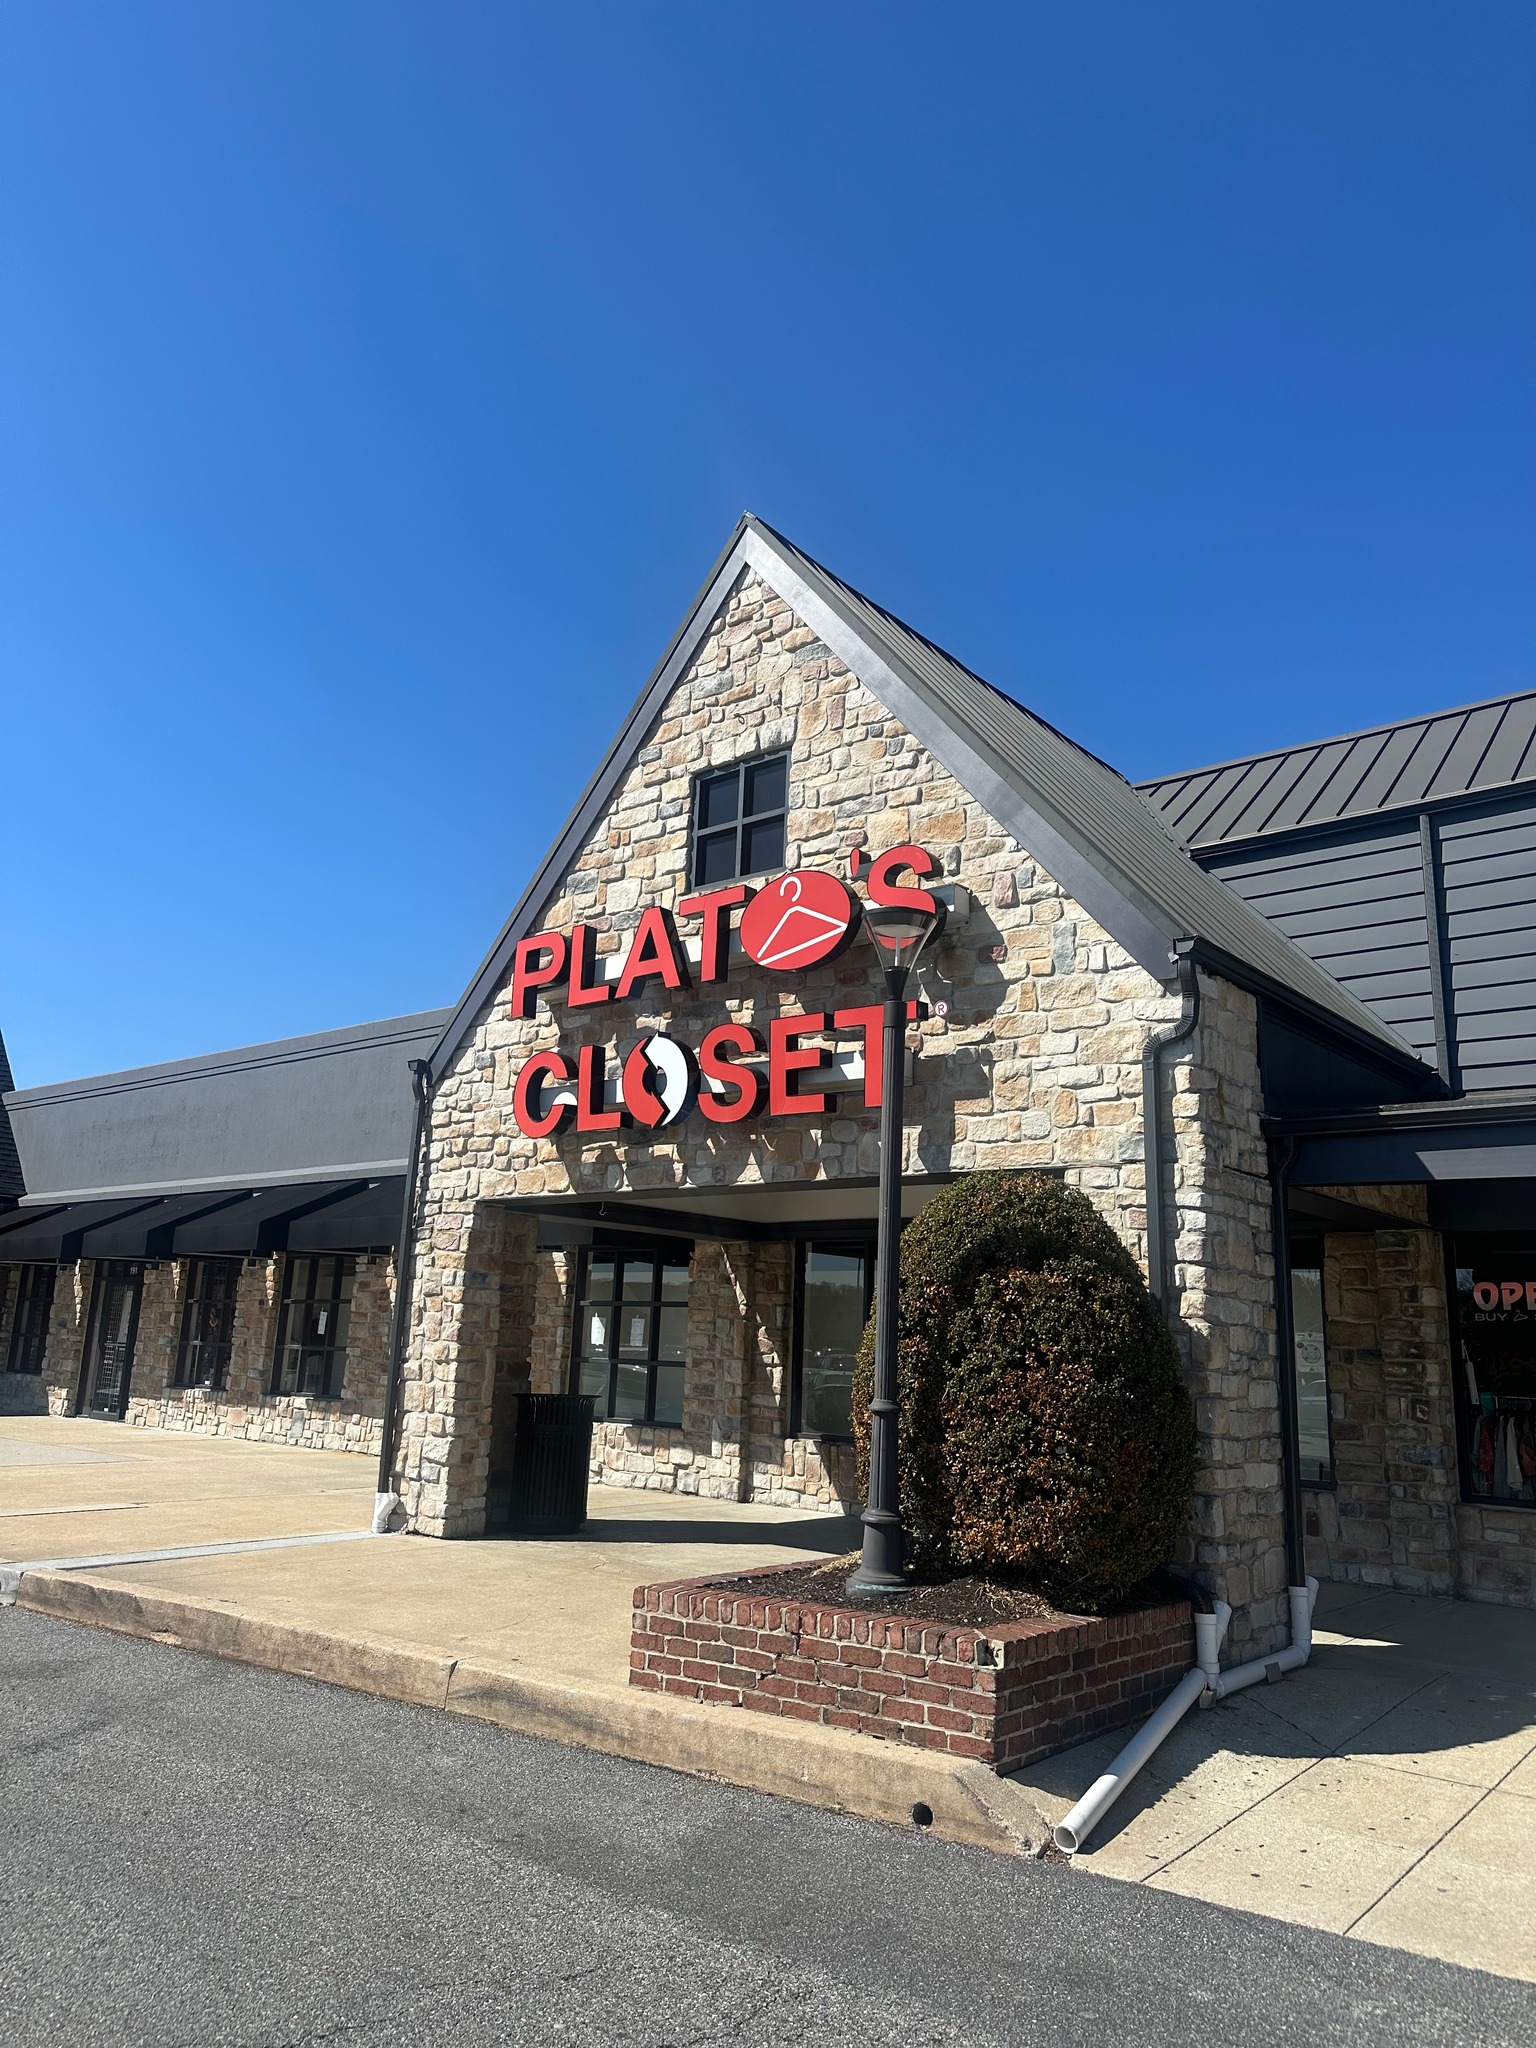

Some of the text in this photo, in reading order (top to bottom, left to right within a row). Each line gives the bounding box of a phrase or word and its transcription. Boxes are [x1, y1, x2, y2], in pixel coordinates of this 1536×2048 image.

[510, 844, 939, 1019] PLATO'S
[513, 1000, 919, 1138] CLOSET
[1474, 1312, 1508, 1321] BUY
